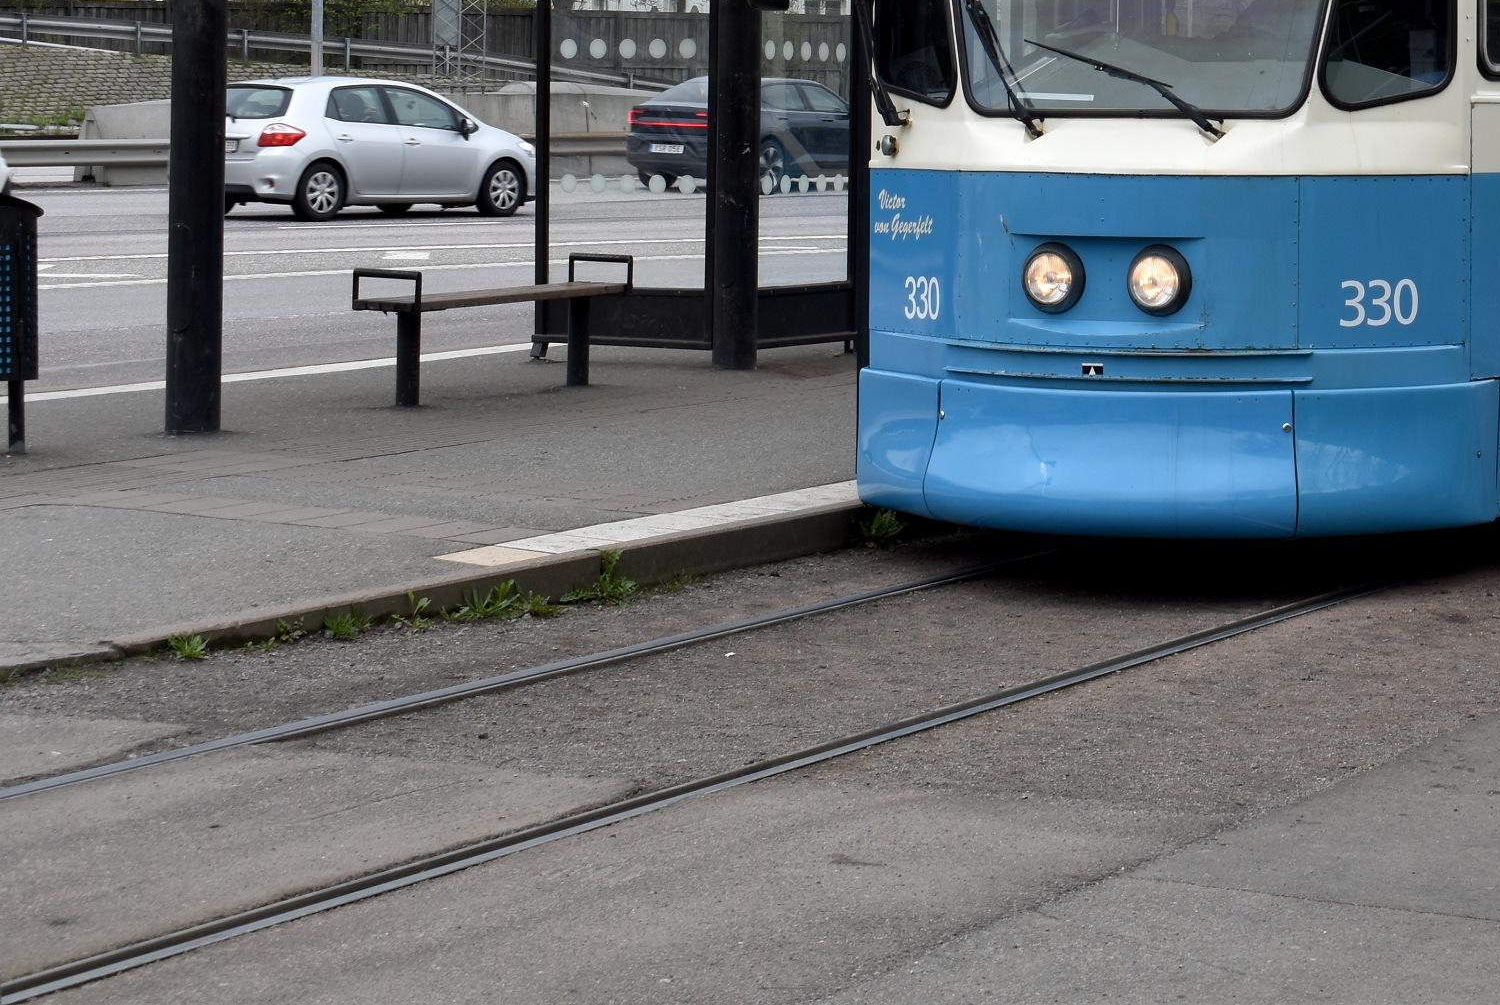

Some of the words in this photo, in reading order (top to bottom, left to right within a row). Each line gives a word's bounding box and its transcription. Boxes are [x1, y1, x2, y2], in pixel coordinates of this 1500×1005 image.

[878, 189, 906, 209] Victor
[874, 221, 890, 233] von
[891, 213, 933, 240] Gegerfelt
[904, 276, 940, 320] 330
[1339, 278, 1419, 327] 330
